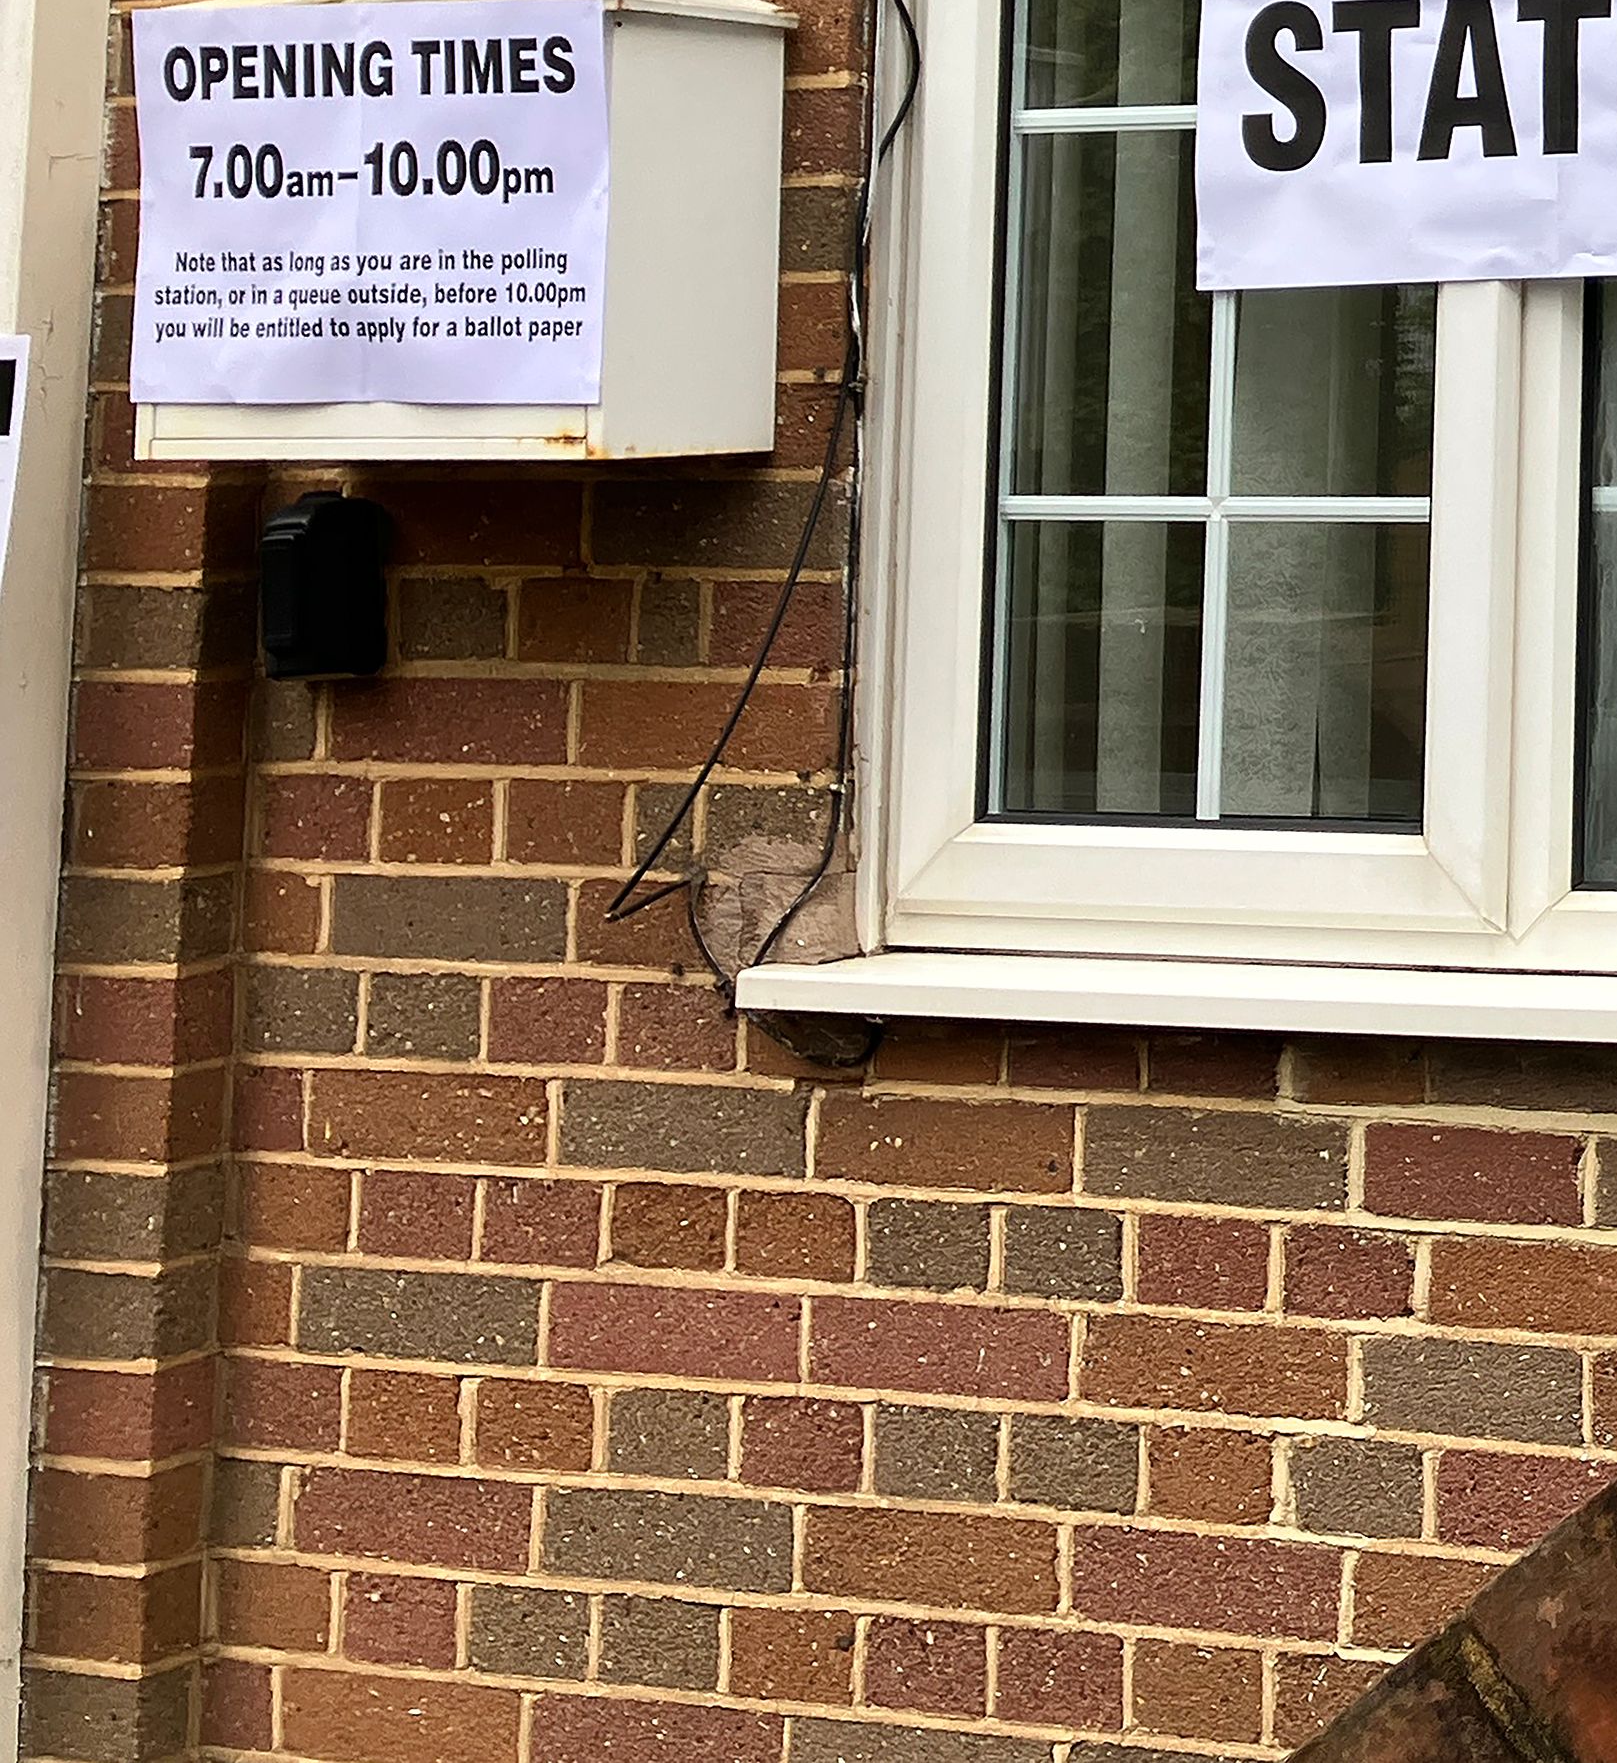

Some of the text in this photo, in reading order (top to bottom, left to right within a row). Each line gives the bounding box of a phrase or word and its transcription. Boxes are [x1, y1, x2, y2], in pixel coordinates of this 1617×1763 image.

[163, 36, 576, 102] OPENING TIMES
[175, 247, 568, 277] Note that as long as you are in the polling
[154, 281, 586, 311] station, or in a queue outside, before 10.00pm
[155, 315, 583, 344] you will be entitled to apply for a ballot paper
